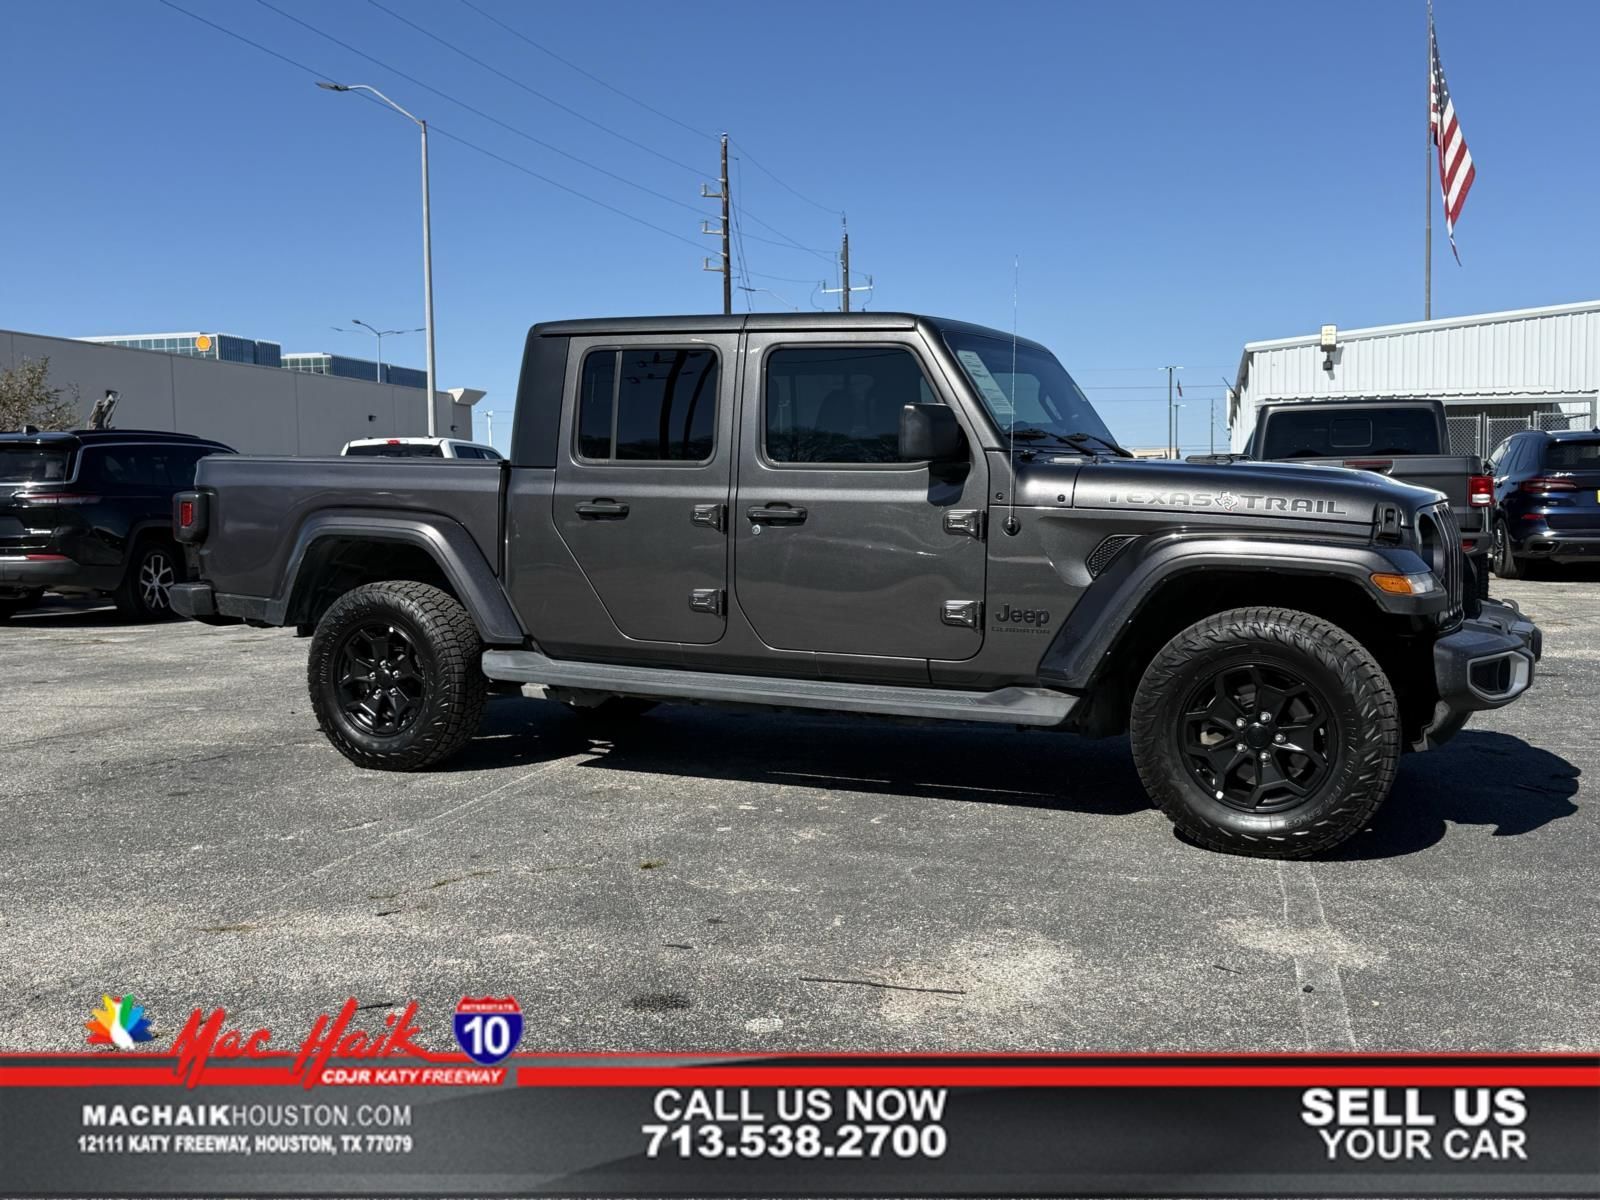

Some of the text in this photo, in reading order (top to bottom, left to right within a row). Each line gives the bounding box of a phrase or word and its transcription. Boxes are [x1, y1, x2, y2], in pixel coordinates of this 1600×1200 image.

[1106, 492, 1347, 515] TEXAS TRAIL
[995, 603, 1050, 628] Jeep
